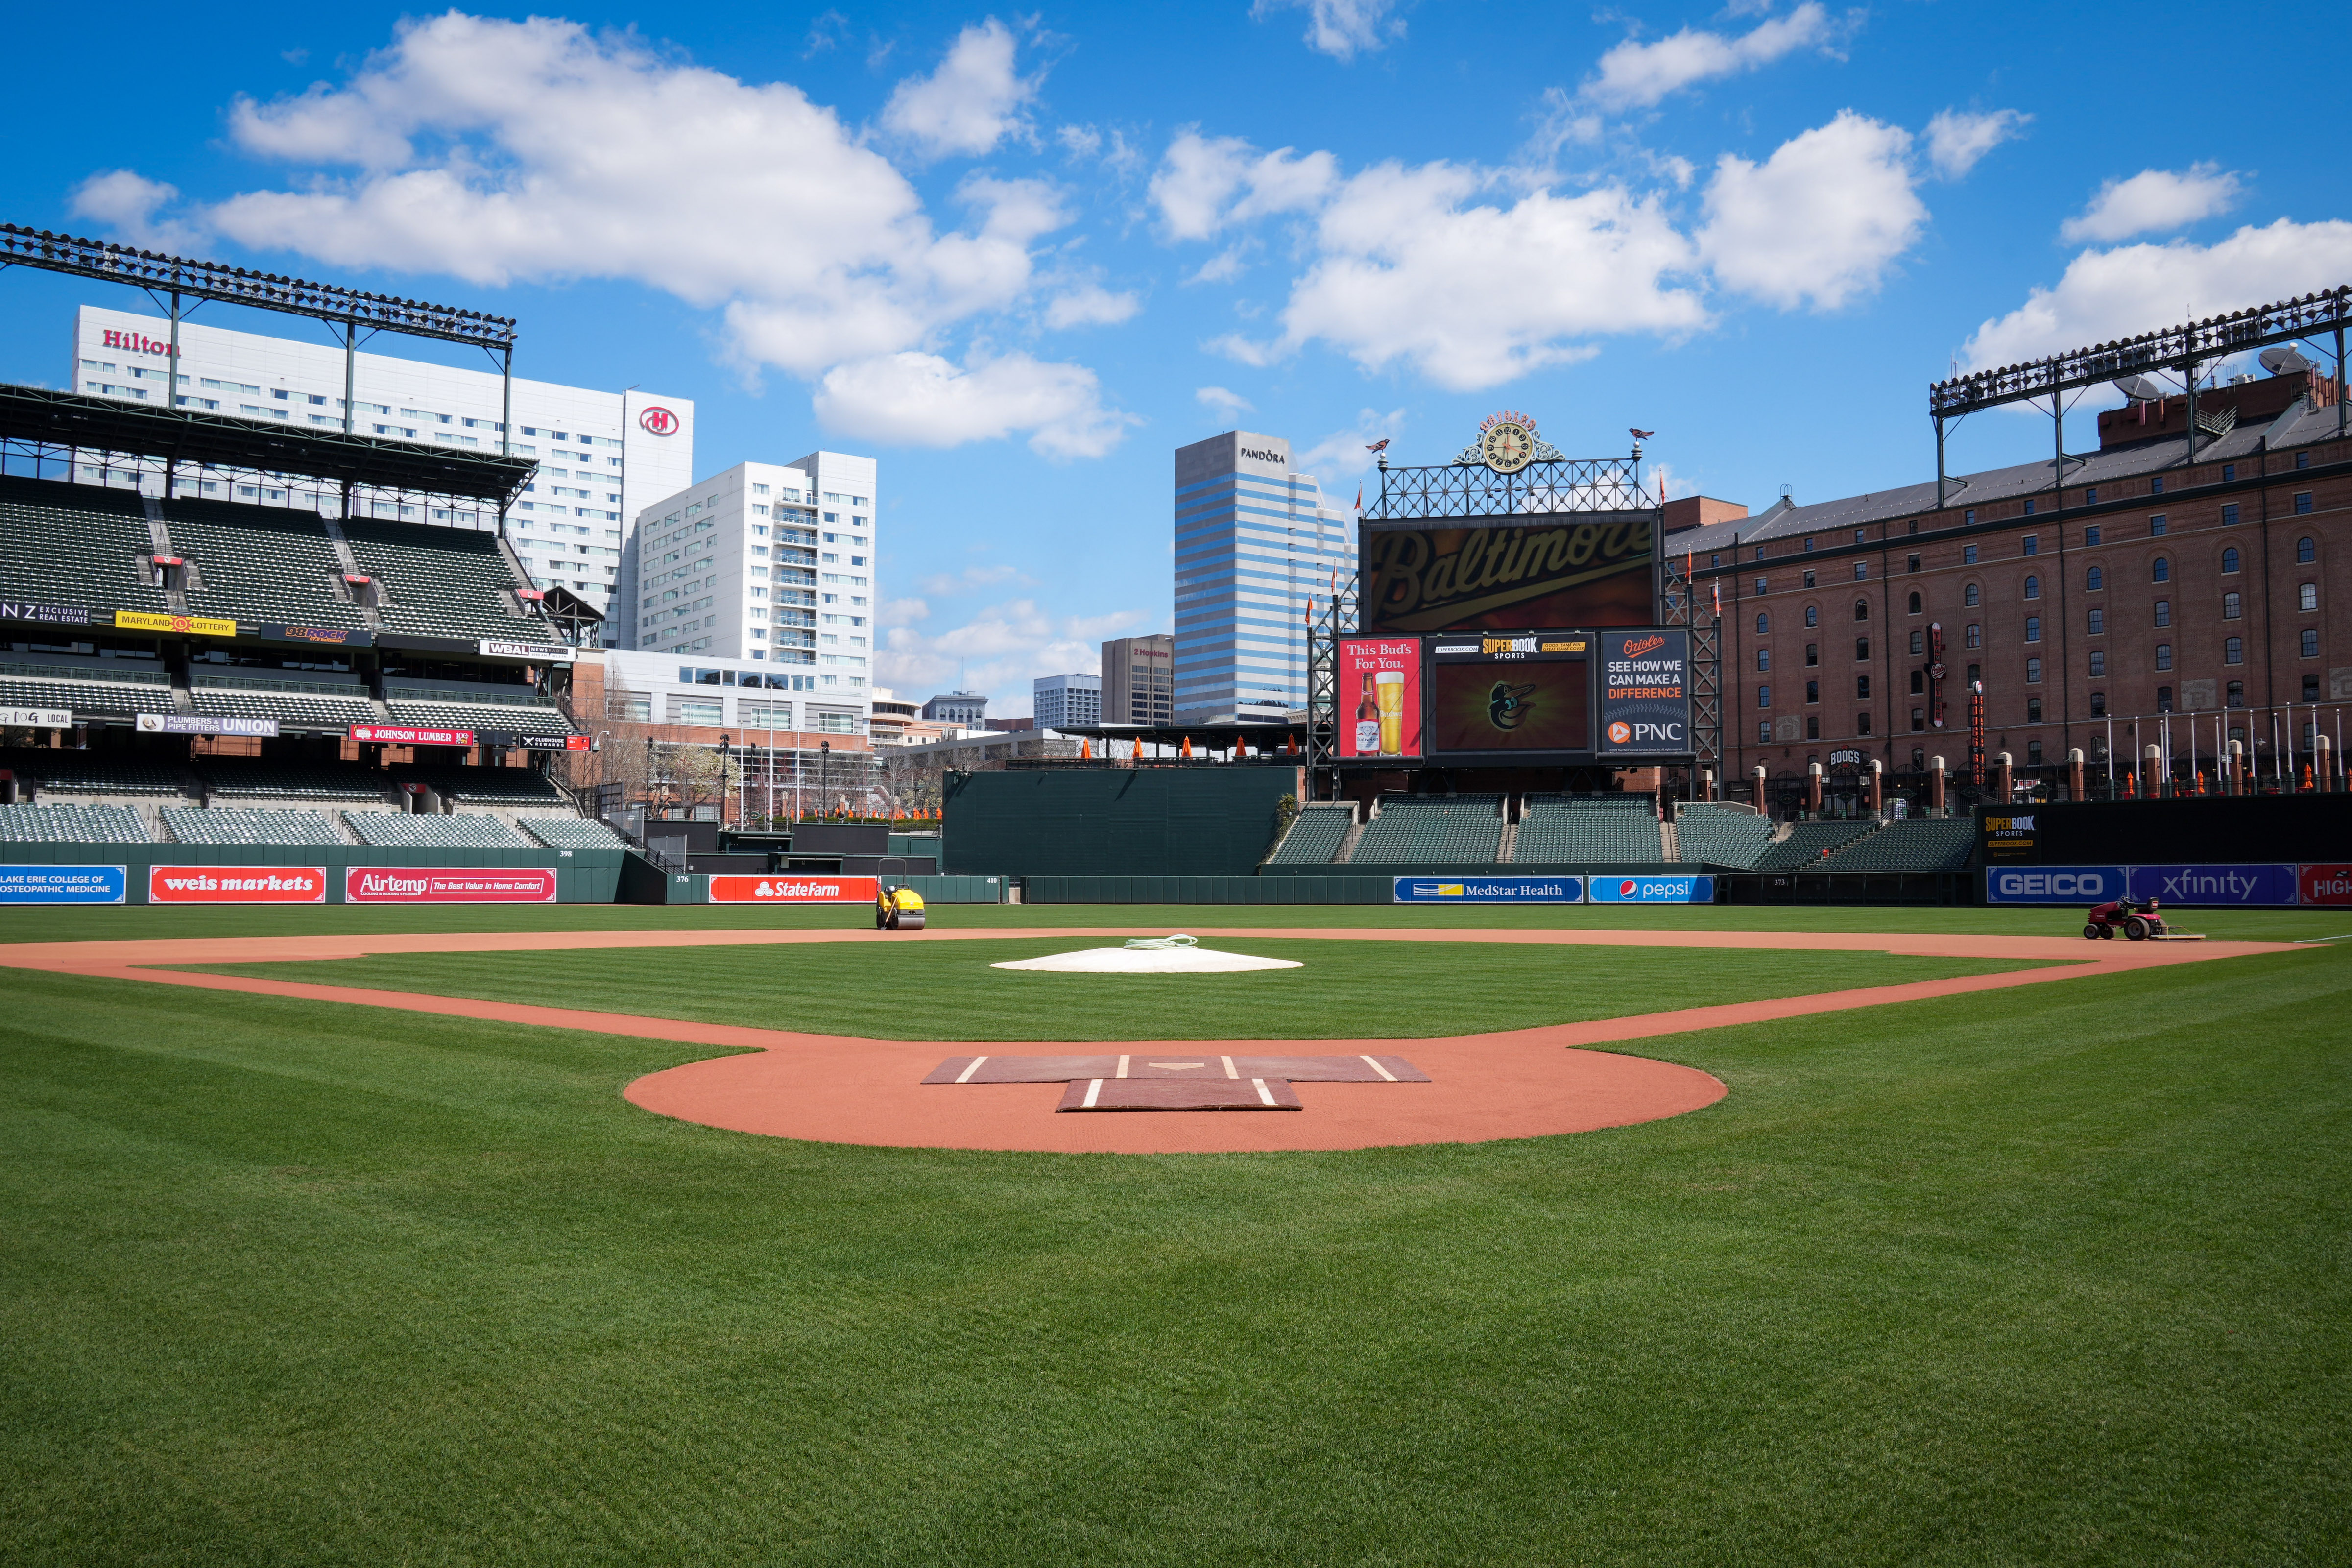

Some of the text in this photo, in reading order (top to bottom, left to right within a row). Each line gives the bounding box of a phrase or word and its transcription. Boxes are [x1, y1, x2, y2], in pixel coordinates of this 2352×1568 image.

[103, 329, 181, 358] Hilton
[1480, 410, 1536, 431] ORIOLES
[1241, 448, 1285, 464] PANDORA
[40, 606, 88, 616] EXCLUSIVE
[122, 616, 170, 626] MARYLAND
[192, 622, 229, 631] LOTTERY
[490, 644, 528, 655] WBAL
[1347, 643, 1412, 655] This Bud's
[1483, 637, 1537, 654] SUPERBOOK
[1623, 635, 1664, 654] Orioles
[1140, 649, 1168, 658] Hopkins
[1355, 658, 1404, 669] For You.
[1608, 660, 1681, 672] SEE HOW WE
[1609, 674, 1680, 685] CAN MAKE A
[1608, 687, 1681, 699] DIFFERENCE
[14, 712, 39, 724] DOG
[48, 714, 68, 723] LOCAL
[168, 716, 212, 725] PLUMBERS
[223, 718, 275, 733] UNION
[1633, 723, 1682, 740] PNC
[375, 729, 451, 742] JOHNSON LUMBER
[1830, 749, 1860, 766] BOOG'S
[1985, 815, 2034, 832] SUPERBOOK
[164, 875, 313, 891] weis markets
[360, 874, 427, 895] Airtemp
[1466, 884, 1563, 895] MedStar Health
[1643, 881, 1689, 898] pepsi
[2000, 874, 2103, 895] GEICO
[2163, 869, 2258, 900] xfinity
